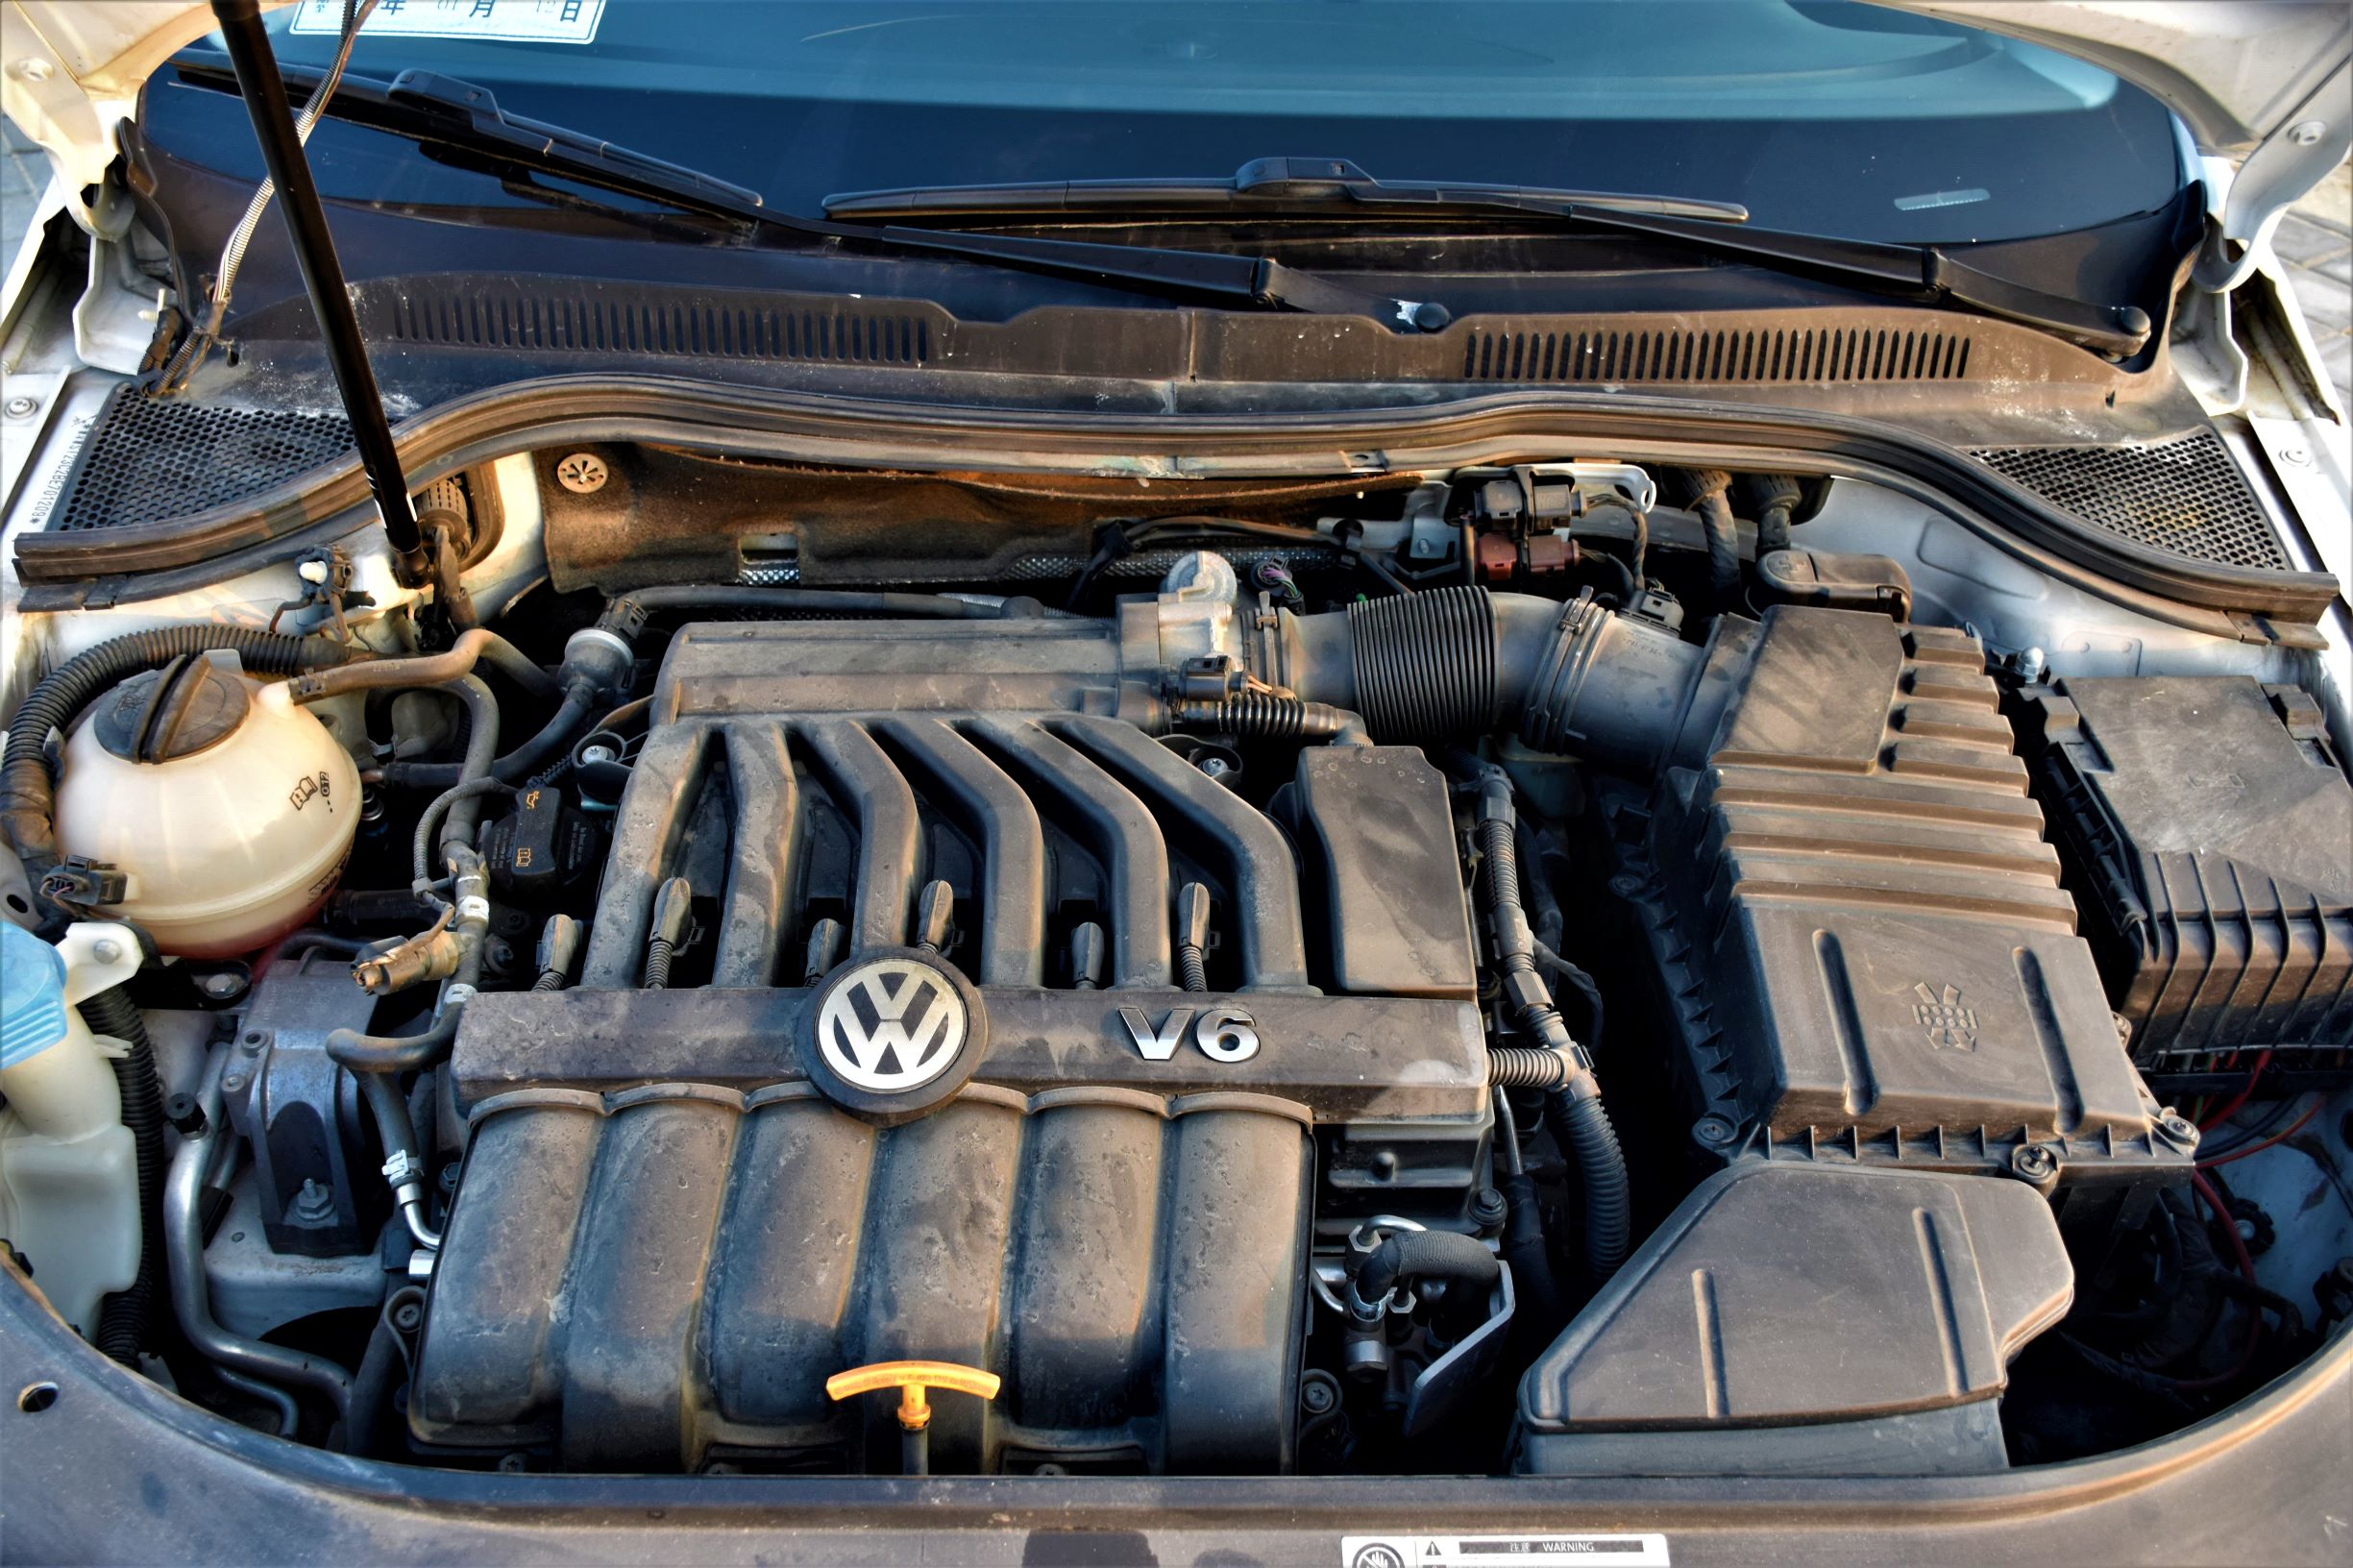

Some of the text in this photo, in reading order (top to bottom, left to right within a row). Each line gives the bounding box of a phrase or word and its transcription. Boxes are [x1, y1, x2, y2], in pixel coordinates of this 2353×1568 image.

[559, 0, 582, 23] 日
[1118, 1007, 1261, 1062] V6
[1542, 1541, 1595, 1553] WARNING
